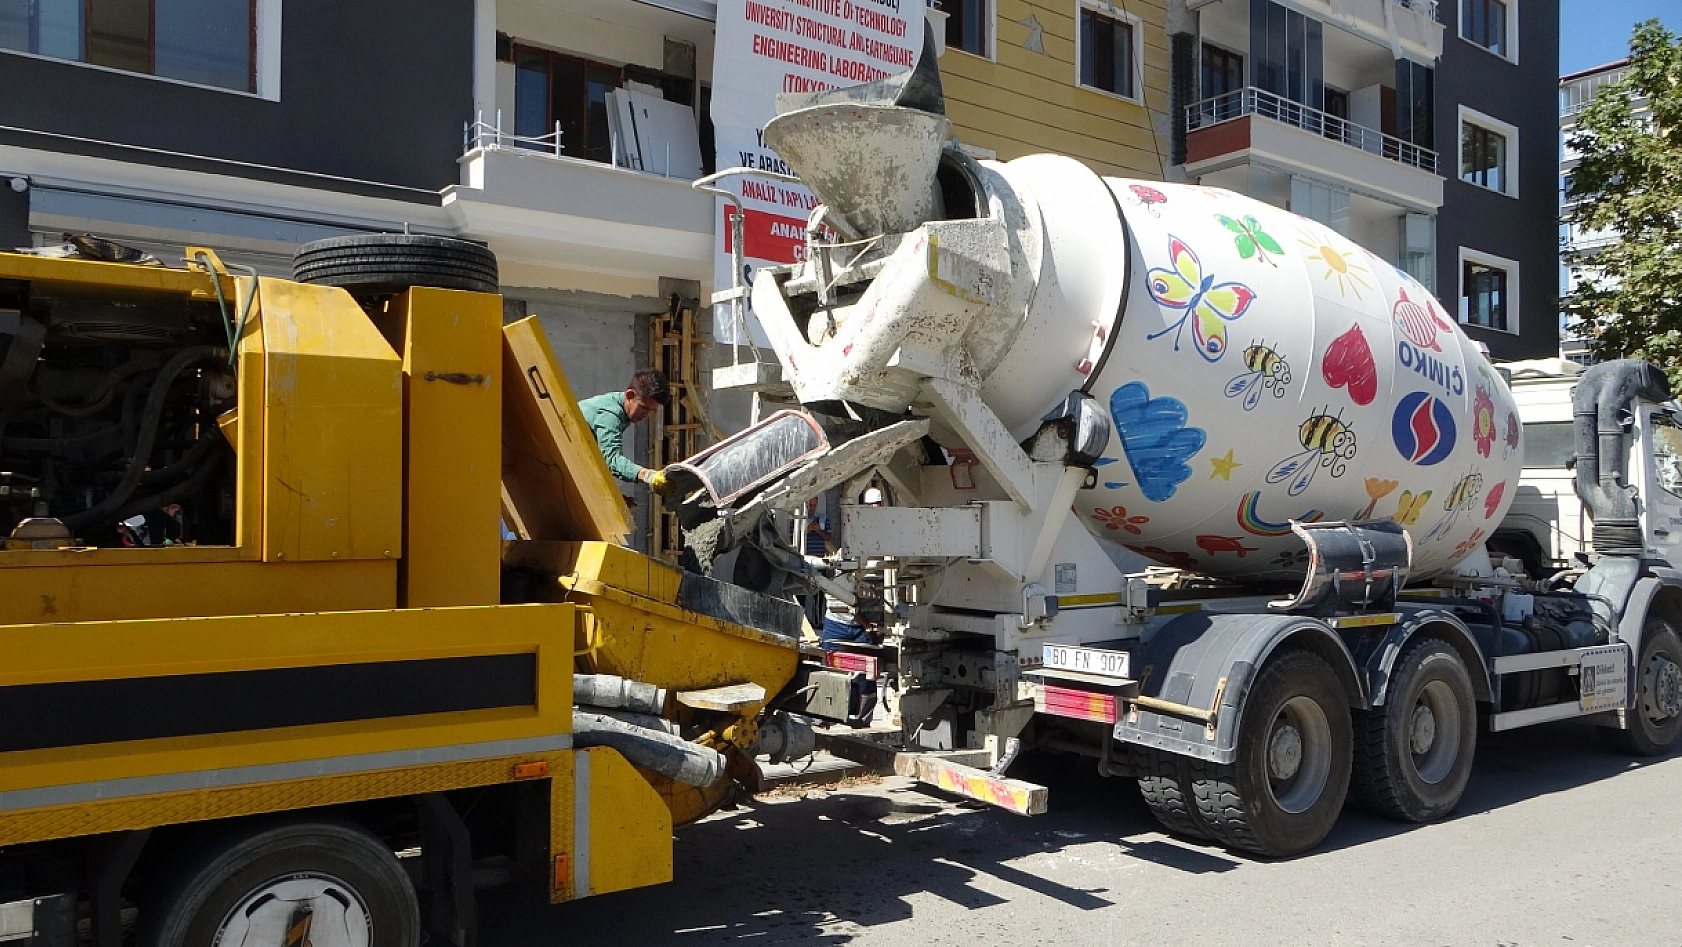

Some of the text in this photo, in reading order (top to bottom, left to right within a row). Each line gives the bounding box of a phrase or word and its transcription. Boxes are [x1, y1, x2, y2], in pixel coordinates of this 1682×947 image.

[796, 17, 847, 49] STRUCTURAL
[854, 5, 907, 38] TECHNOLOGY
[752, 34, 827, 72] ENGINEERING
[739, 151, 755, 169] VE
[742, 179, 777, 204] ANALİZ
[1399, 340, 1464, 396] ÇİMKO
